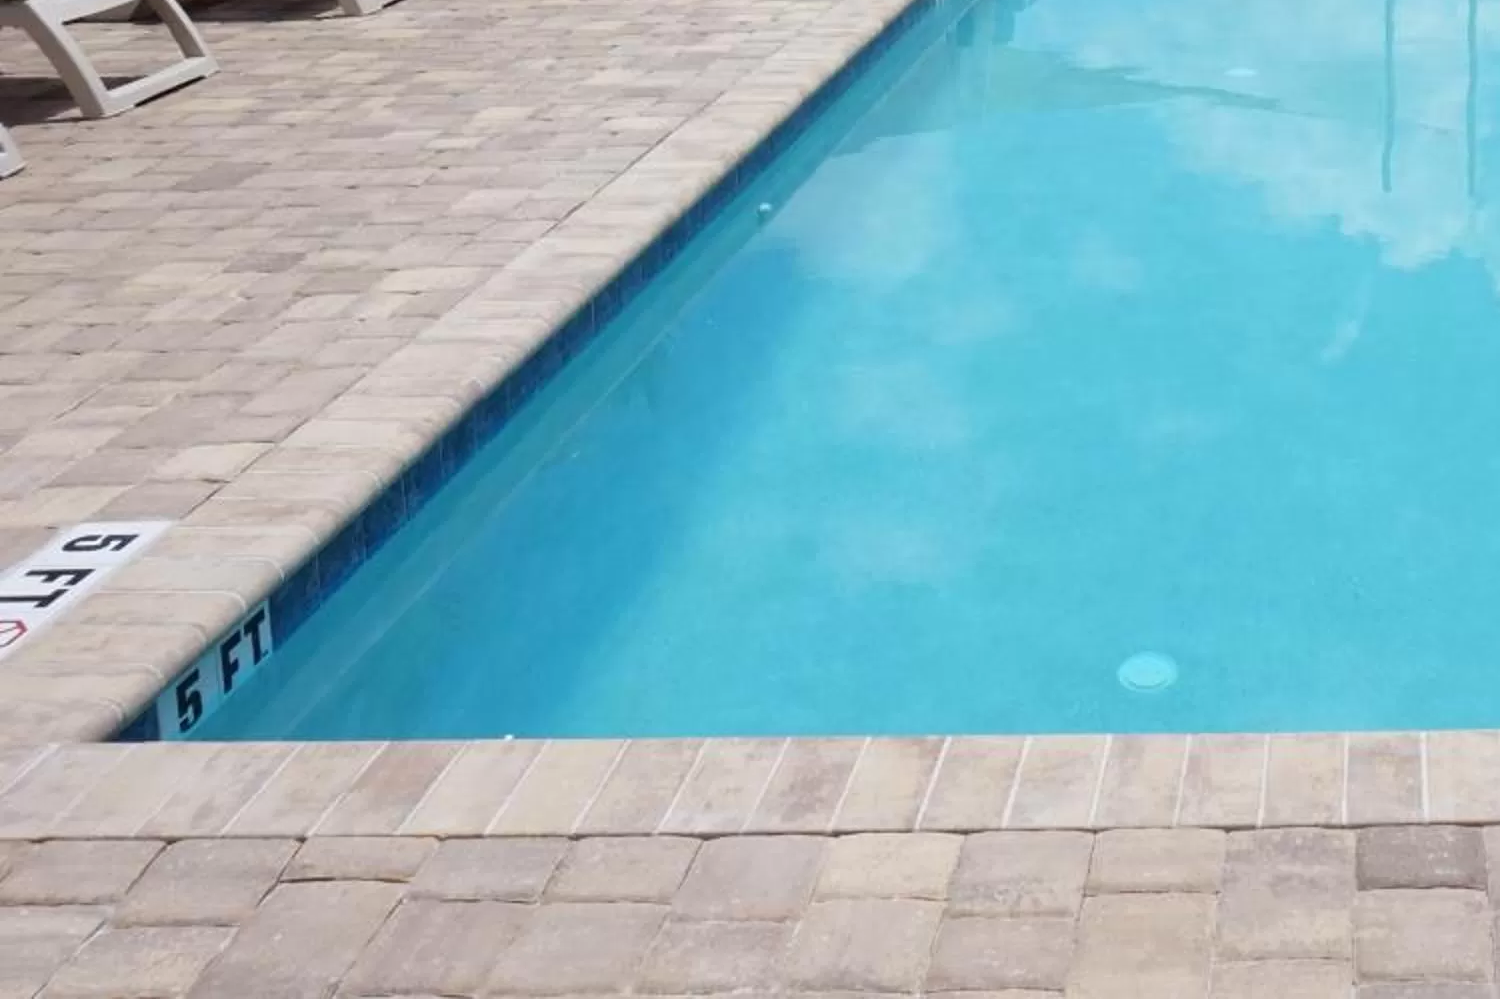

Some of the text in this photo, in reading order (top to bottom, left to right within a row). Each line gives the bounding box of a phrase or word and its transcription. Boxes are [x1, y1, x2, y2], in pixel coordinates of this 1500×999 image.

[0, 533, 139, 608] 5 FT
[176, 667, 203, 733] 5
